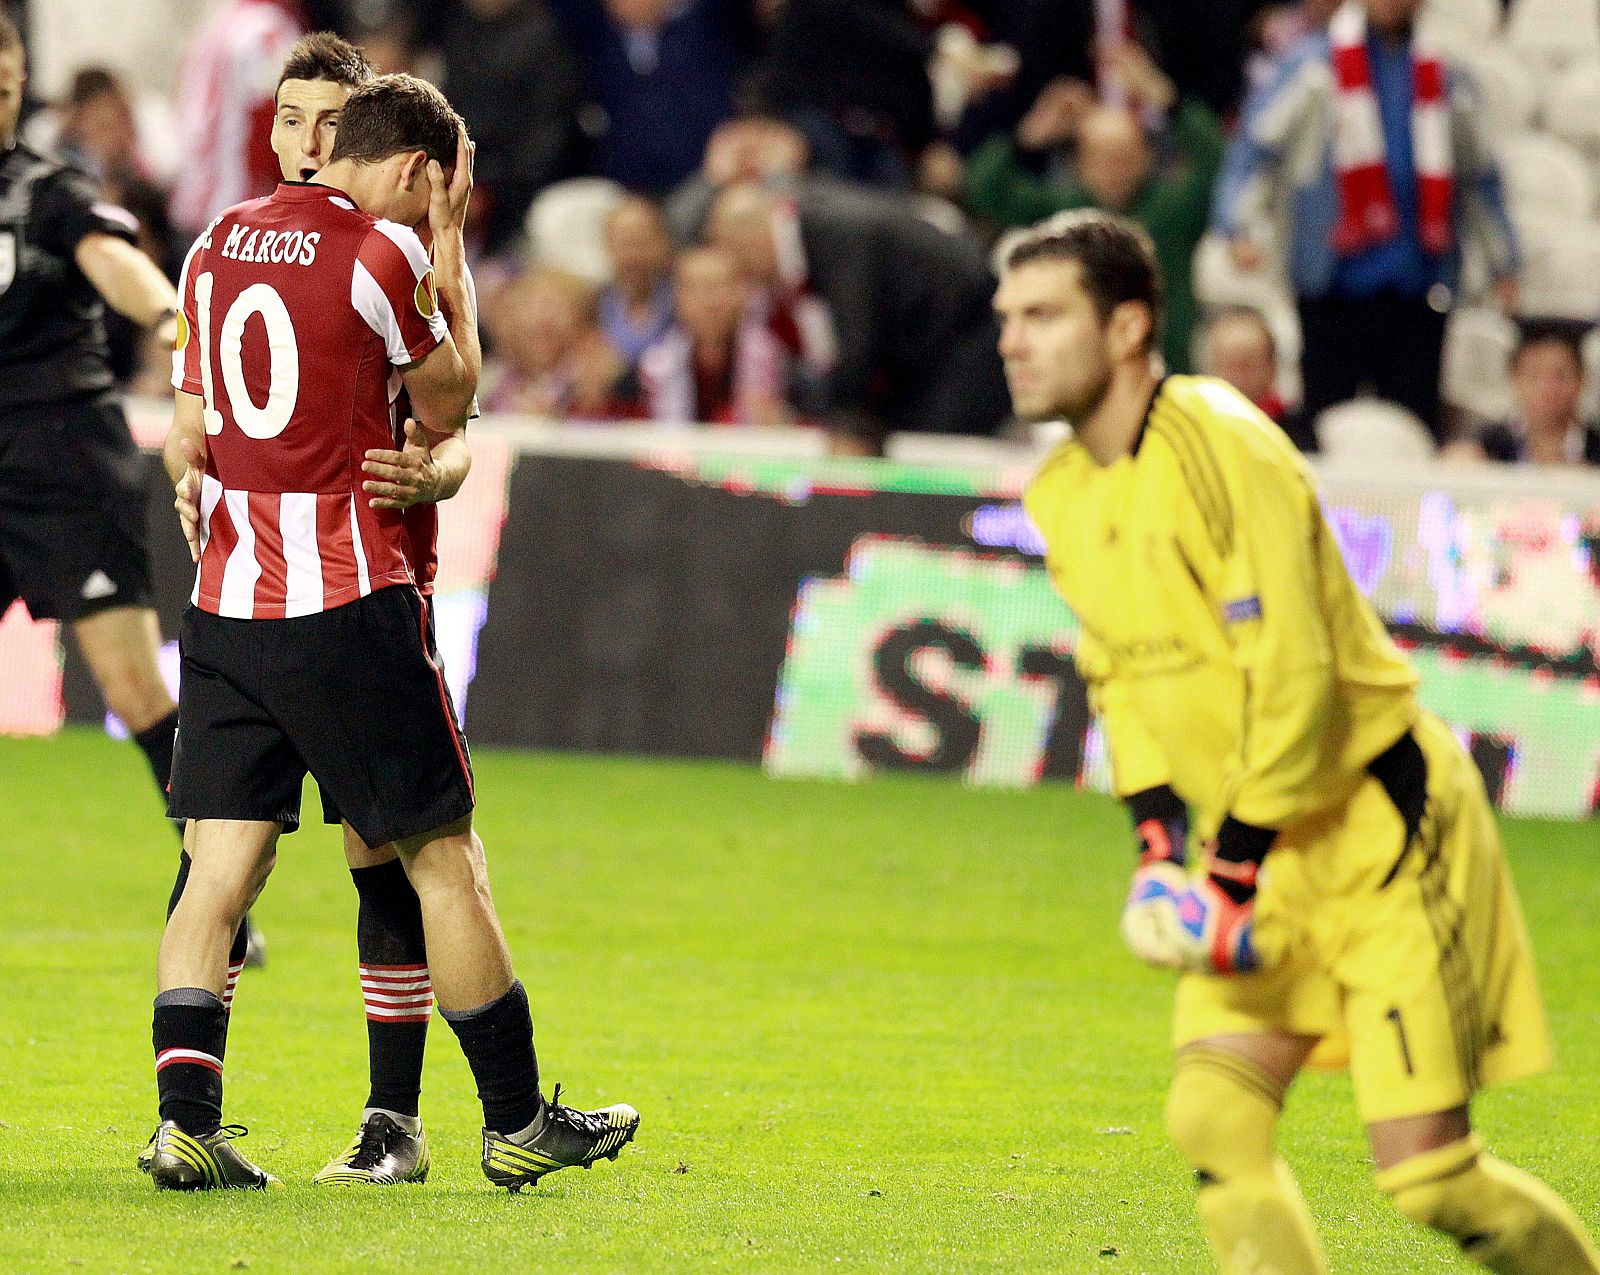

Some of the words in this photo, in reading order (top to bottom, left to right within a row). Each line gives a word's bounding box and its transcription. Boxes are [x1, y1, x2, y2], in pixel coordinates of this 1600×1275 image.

[221, 223, 321, 267] MARCOS
[195, 271, 299, 440] 10
[1385, 1007, 1413, 1077] 1
